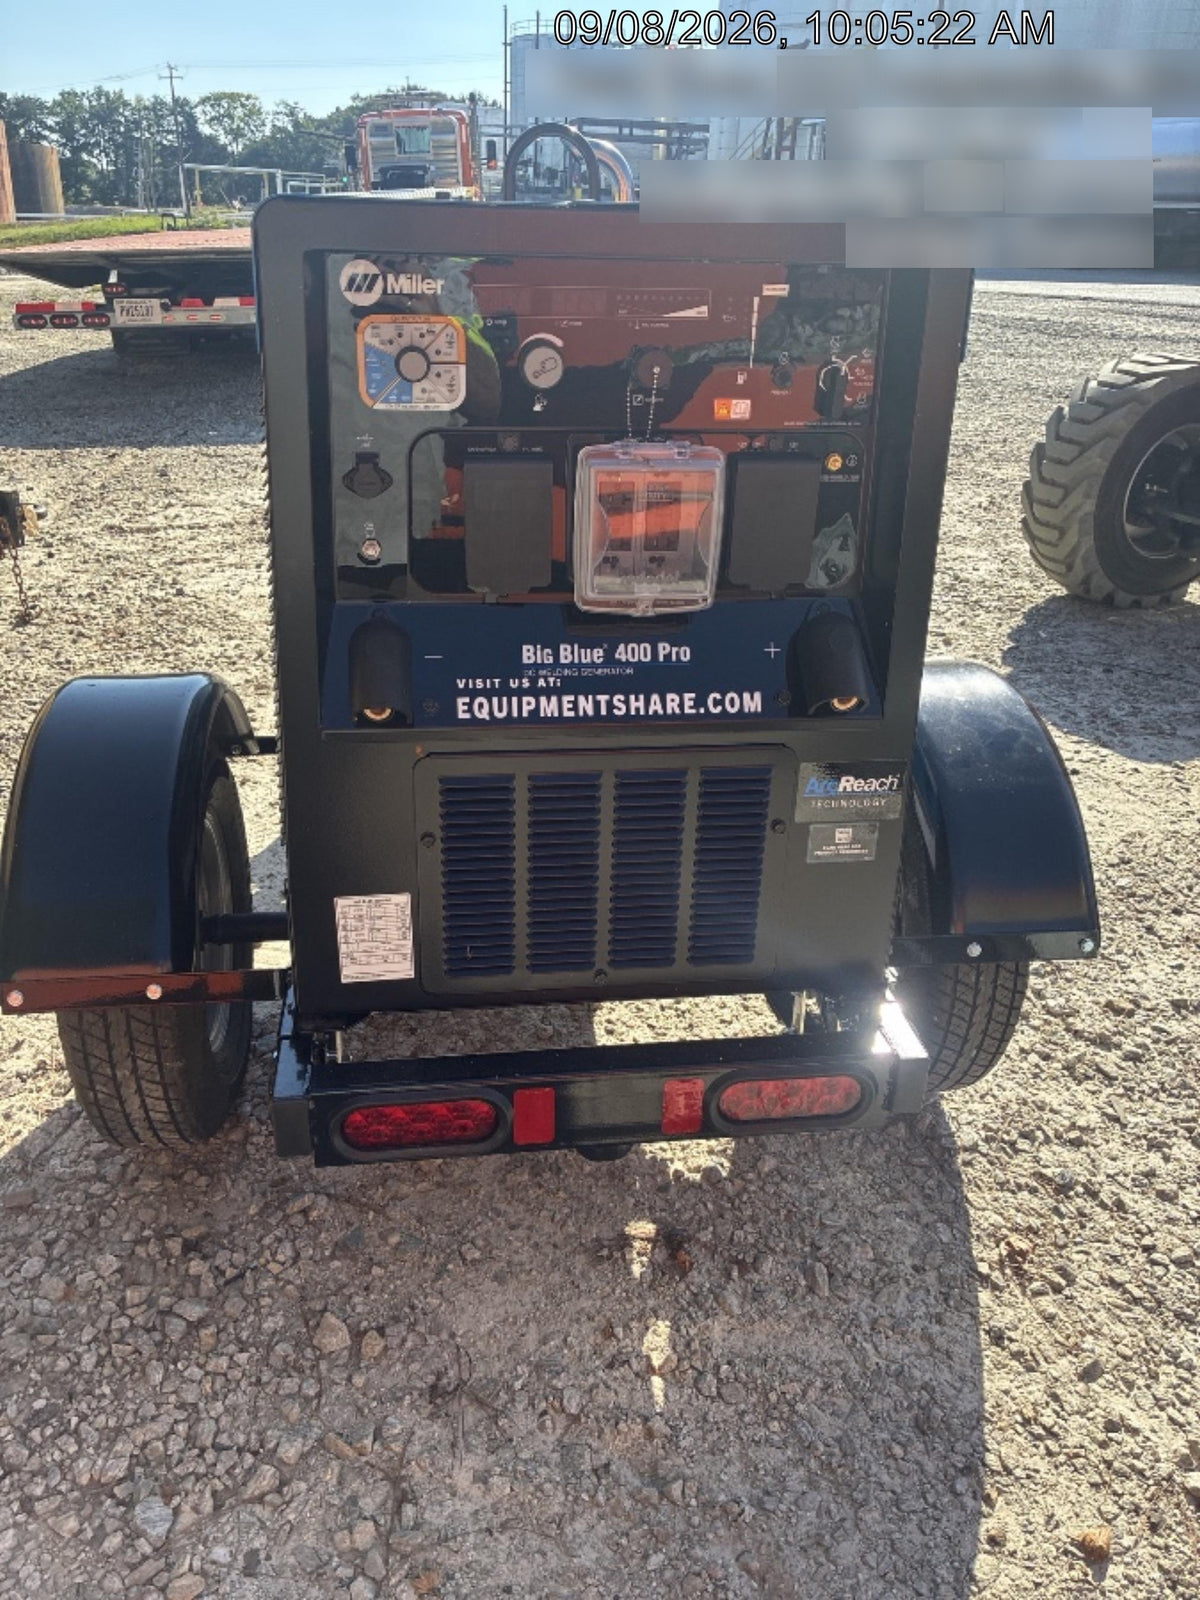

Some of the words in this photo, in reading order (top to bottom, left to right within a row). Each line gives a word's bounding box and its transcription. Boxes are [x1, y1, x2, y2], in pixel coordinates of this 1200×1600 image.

[386, 273, 445, 295] Miller
[614, 643, 651, 662] 400
[657, 642, 691, 662] Pro
[456, 678, 501, 689] VISIT
[510, 678, 530, 688] US
[456, 691, 763, 721] EQUIPMENTSHARE.COM
[803, 774, 898, 797] ArcReach
[811, 798, 887, 809] TECHNOLOGY
